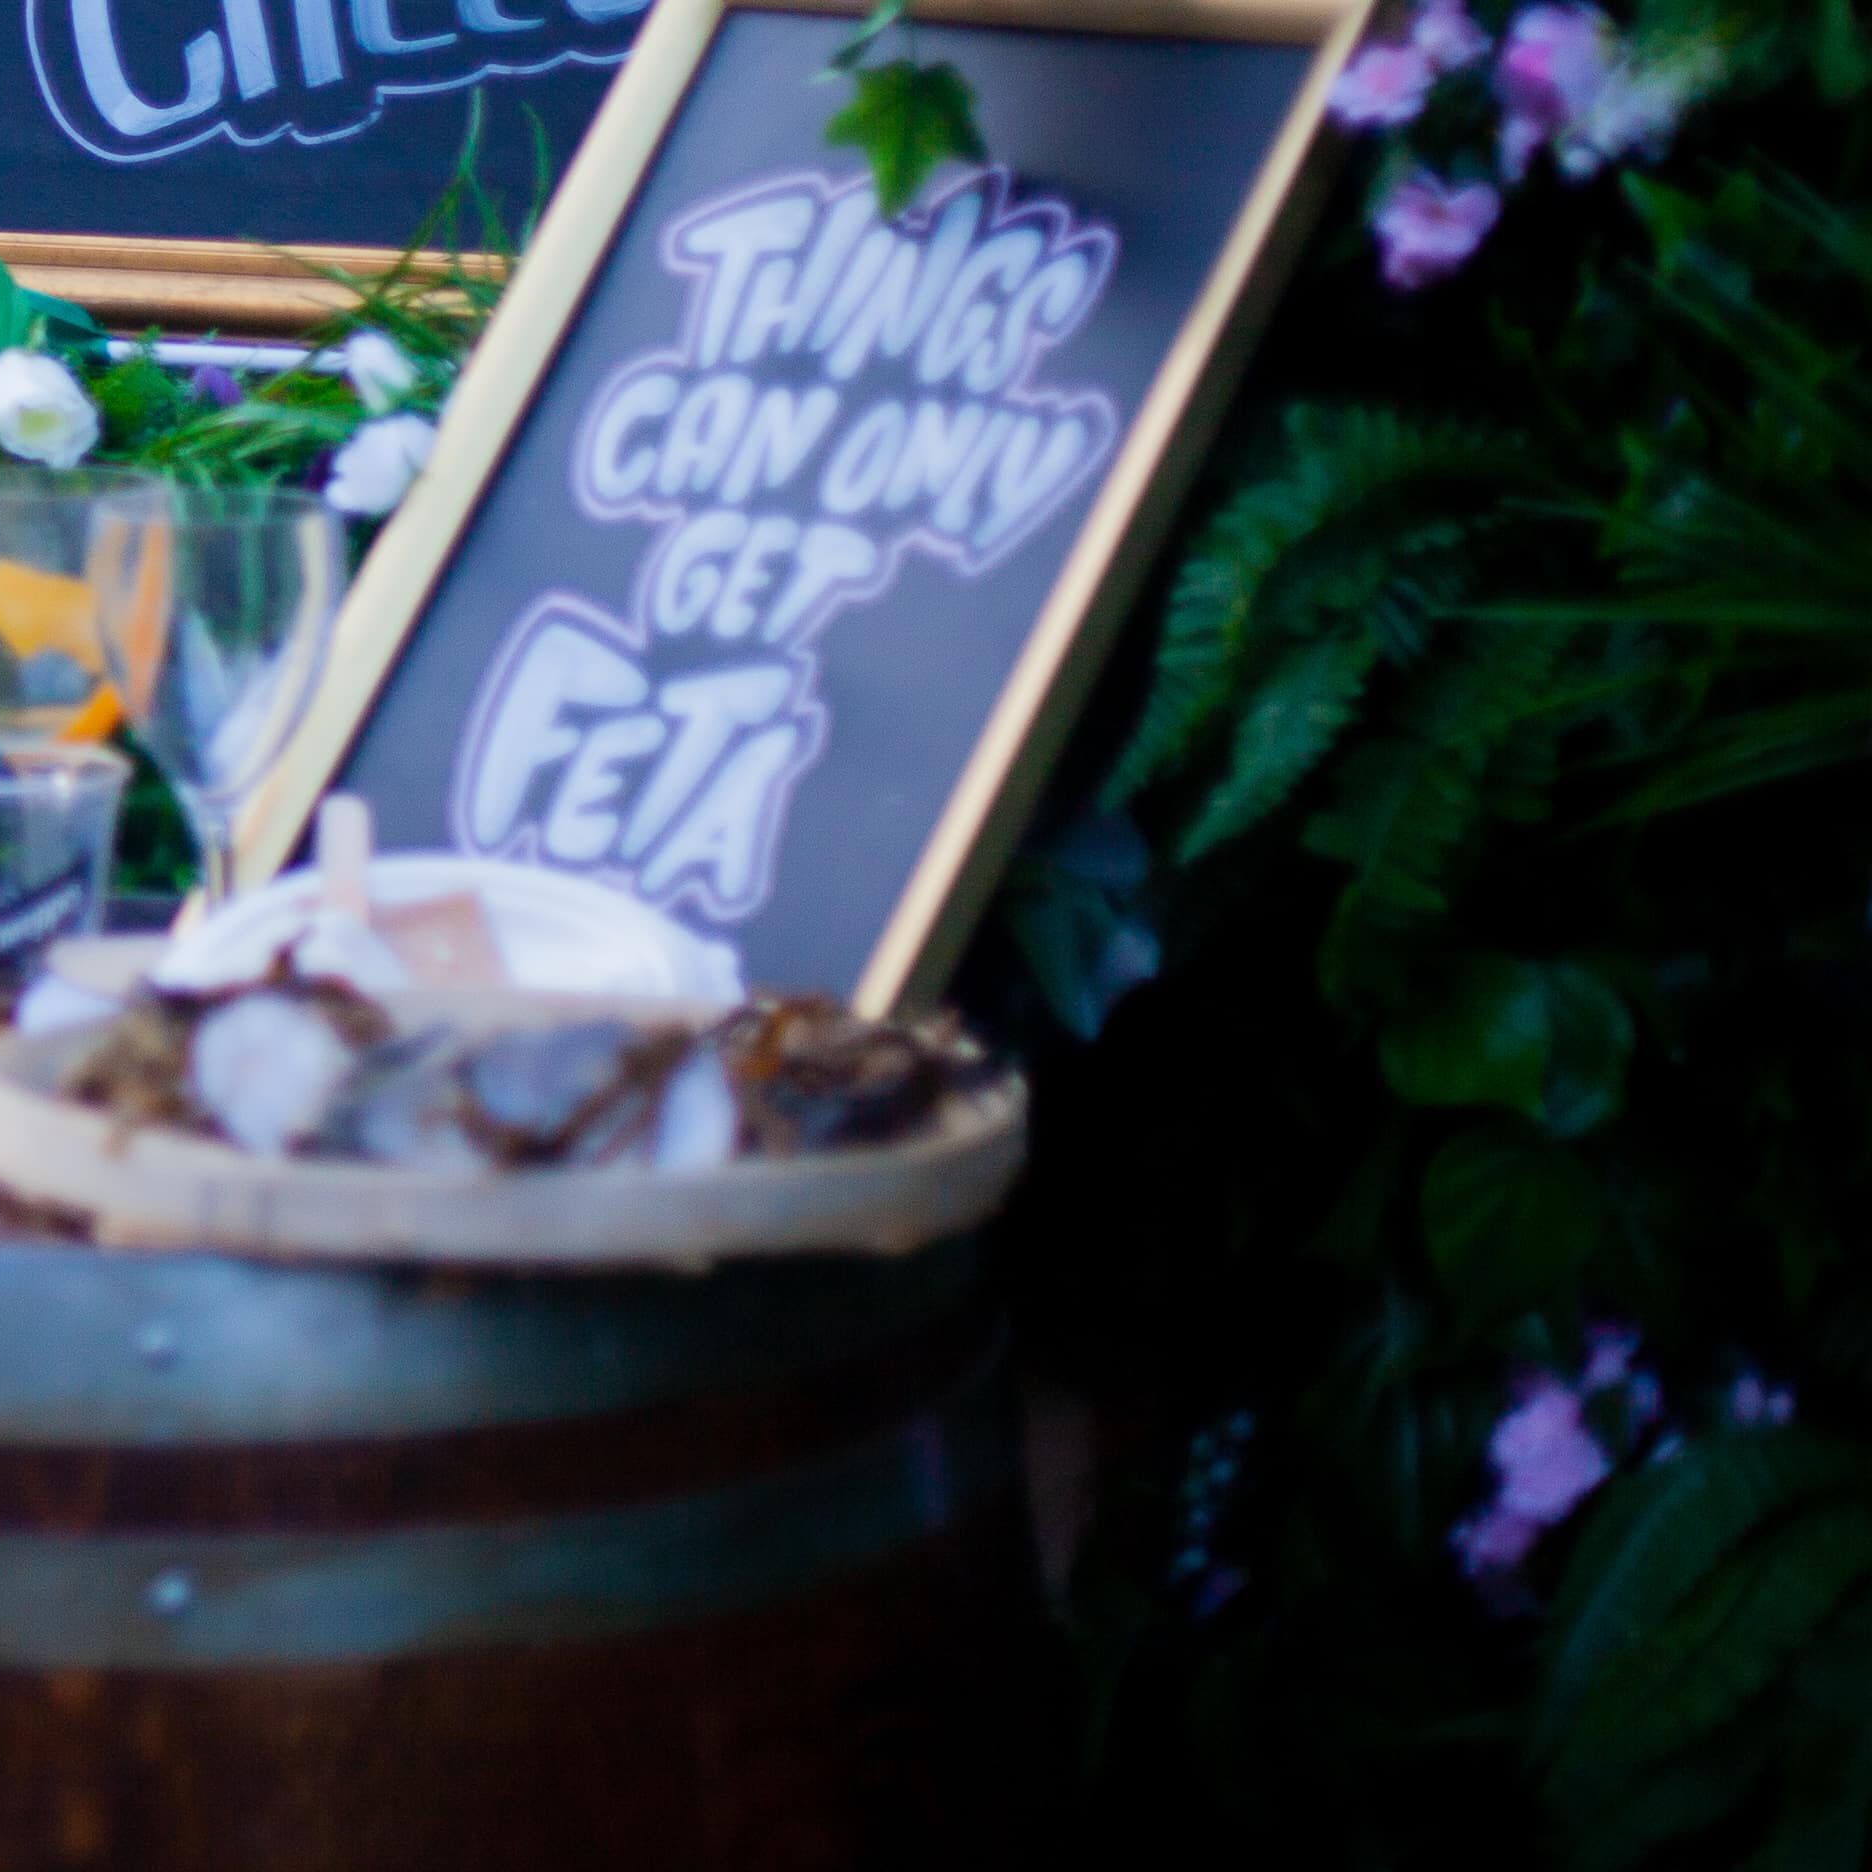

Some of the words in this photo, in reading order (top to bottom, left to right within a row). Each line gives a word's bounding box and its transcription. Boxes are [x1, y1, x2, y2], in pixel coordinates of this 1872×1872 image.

[684, 192, 1089, 394] THINGS
[593, 374, 840, 502] CAN
[820, 398, 1087, 550] ONLY
[656, 514, 877, 645] GET
[471, 622, 797, 900] FETA
